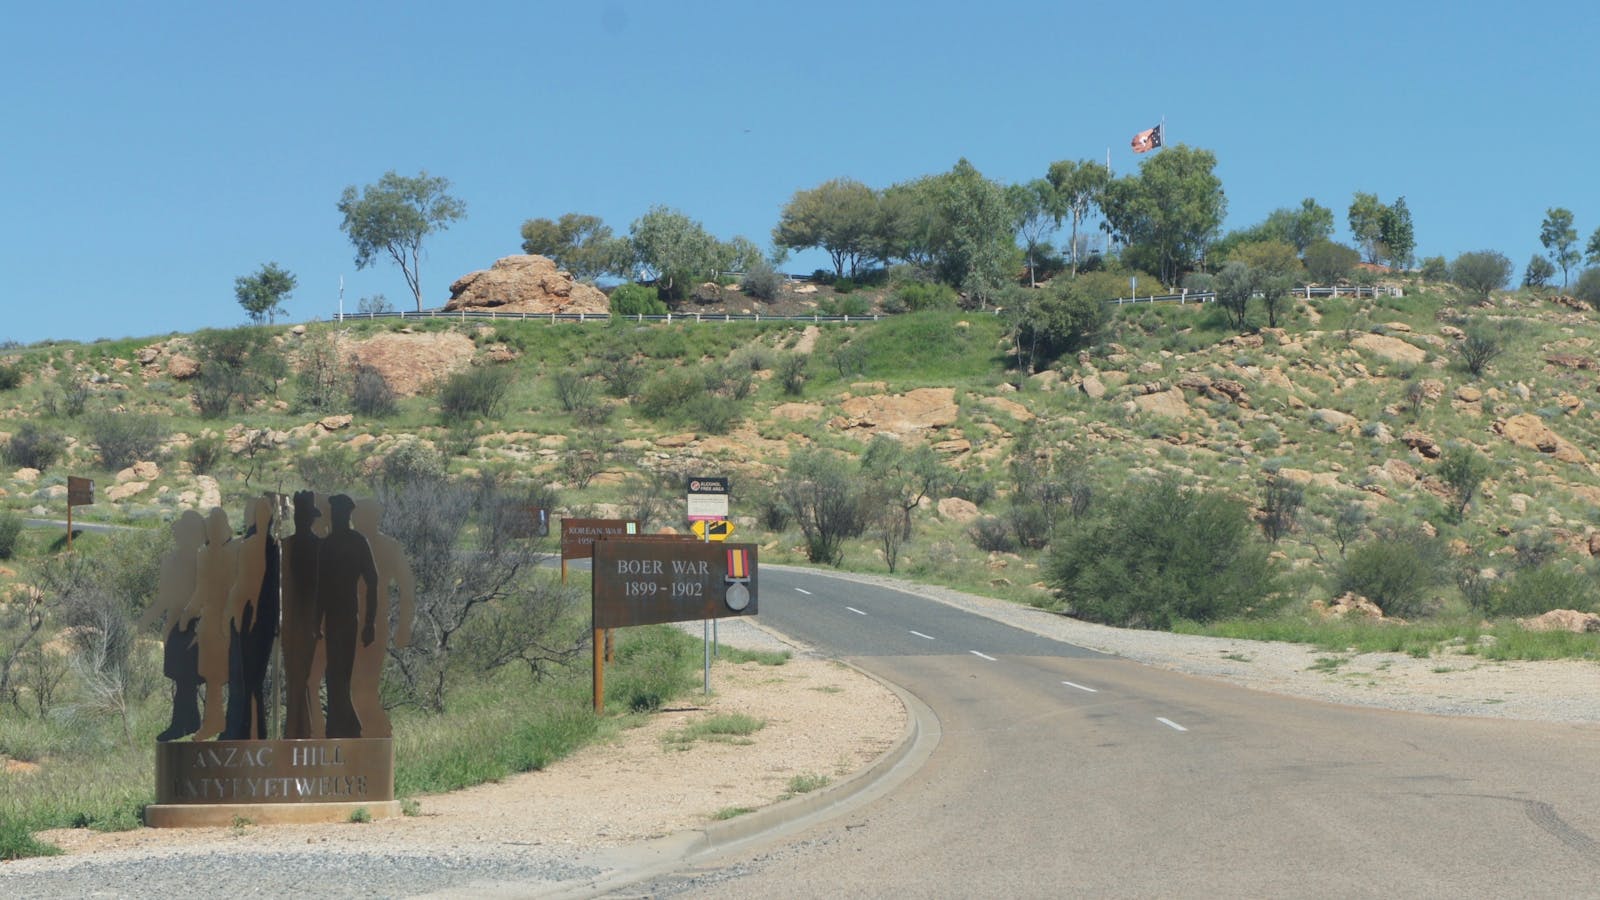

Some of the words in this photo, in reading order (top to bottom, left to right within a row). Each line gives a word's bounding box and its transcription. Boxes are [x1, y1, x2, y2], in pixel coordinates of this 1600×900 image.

[605, 527, 623, 535] WAR
[617, 559, 664, 575] BOER
[671, 560, 710, 575] WAR
[192, 746, 273, 769] ANZAC
[292, 745, 345, 768] HILL
